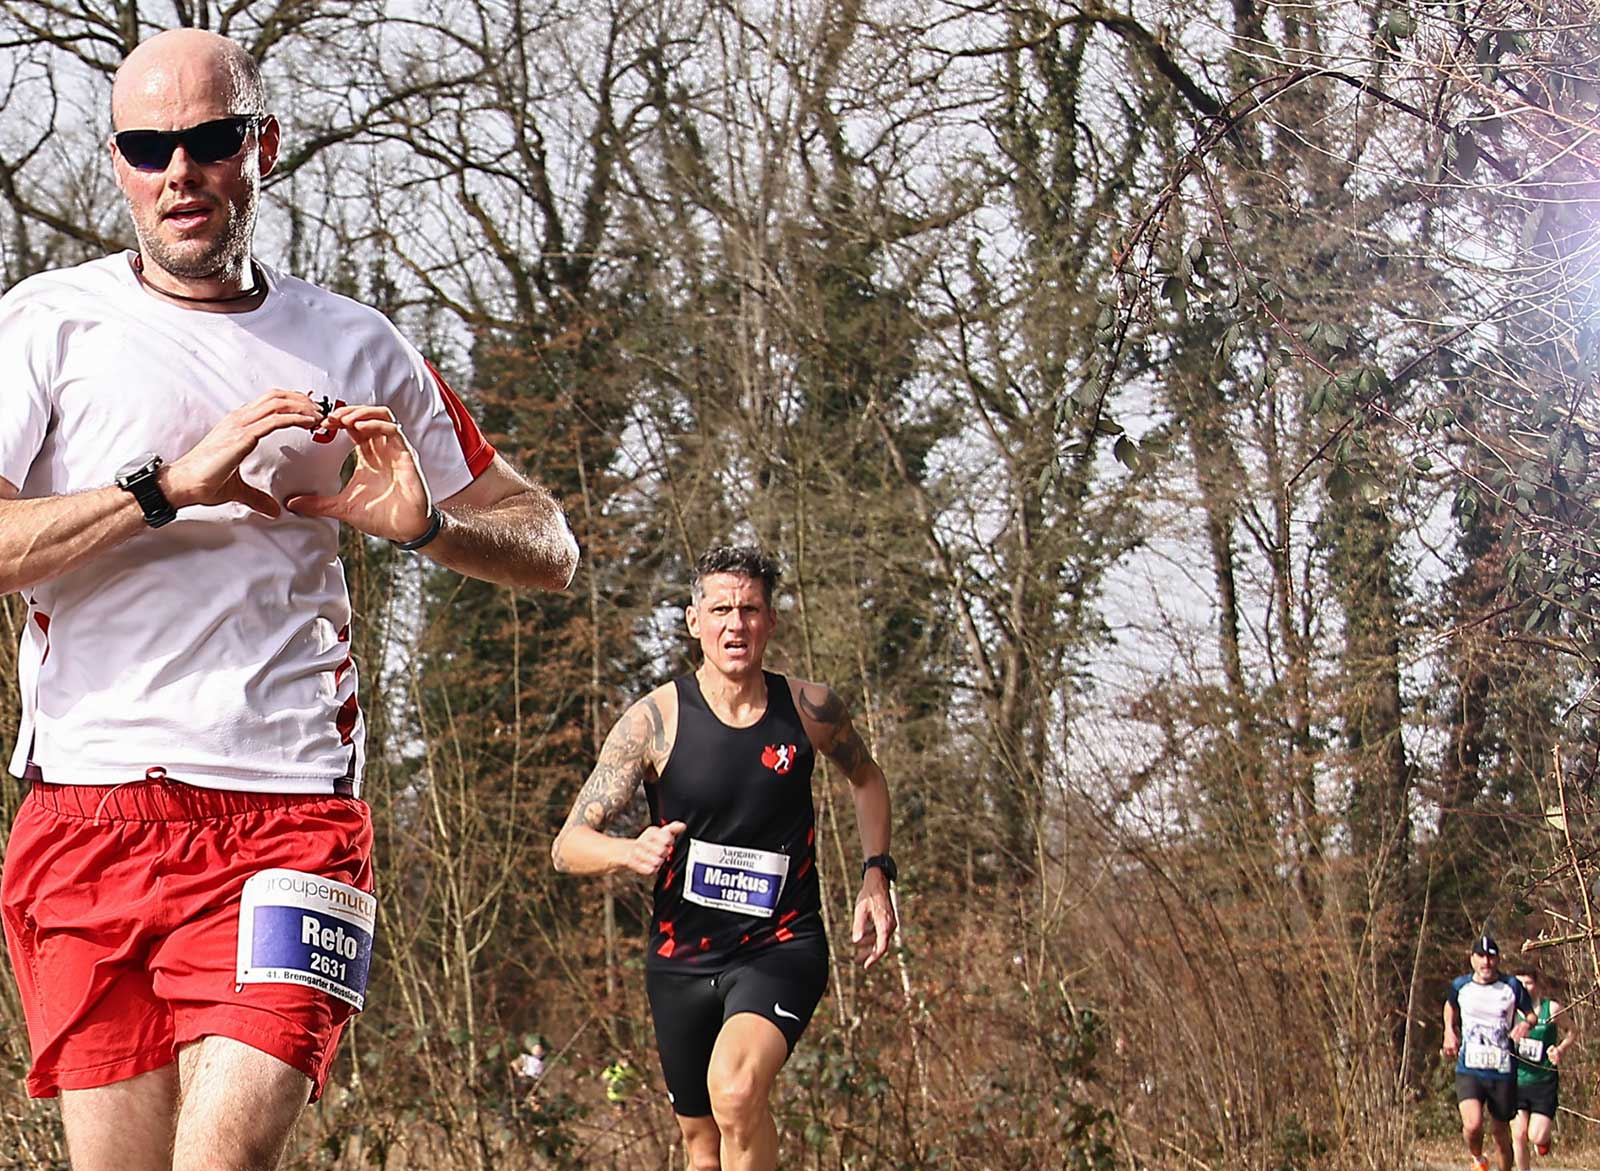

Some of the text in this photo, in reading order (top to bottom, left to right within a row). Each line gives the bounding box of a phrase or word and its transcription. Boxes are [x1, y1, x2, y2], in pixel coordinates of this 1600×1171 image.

[703, 867, 769, 893] Markus
[301, 914, 357, 960] Reto
[266, 970, 281, 979] 41.
[284, 971, 329, 989] Bremgarter
[310, 952, 347, 981] 2631
